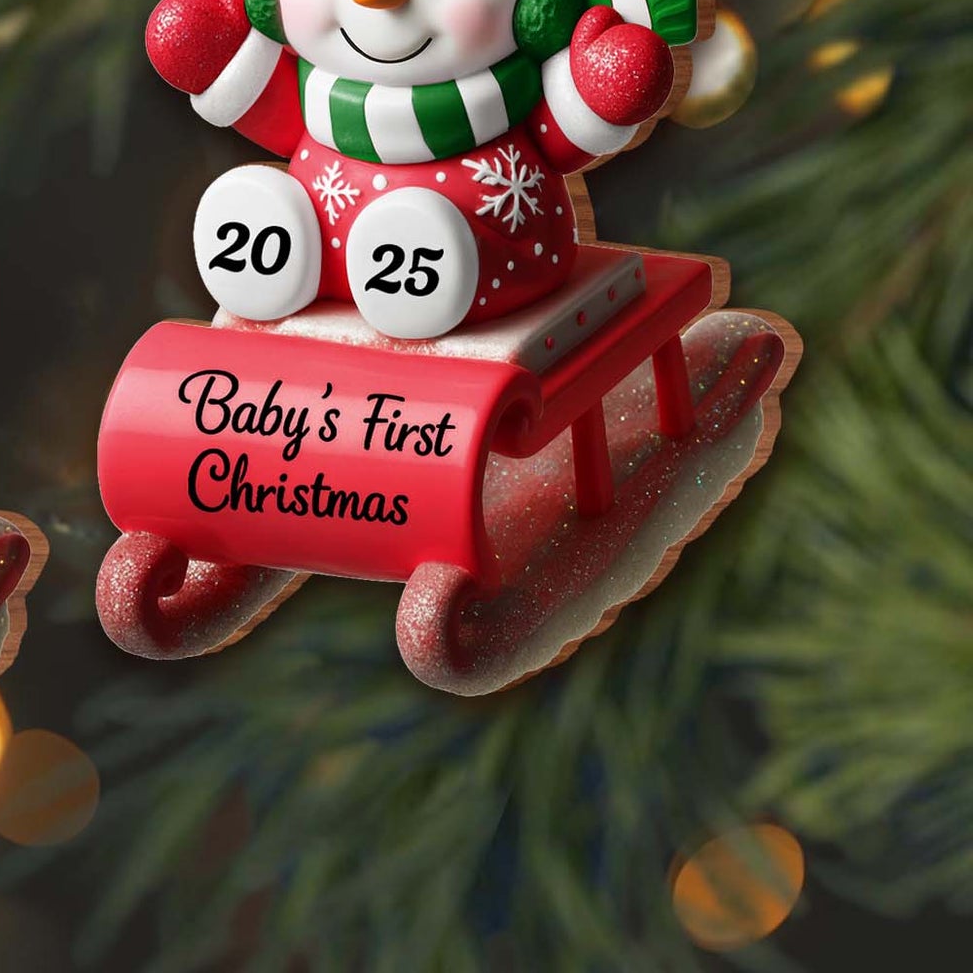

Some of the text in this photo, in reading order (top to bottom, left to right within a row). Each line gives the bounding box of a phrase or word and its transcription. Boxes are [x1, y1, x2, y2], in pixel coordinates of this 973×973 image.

[208, 221, 445, 297] 20 25
[178, 369, 456, 462] Baby's First
[187, 448, 409, 526] Christmas
